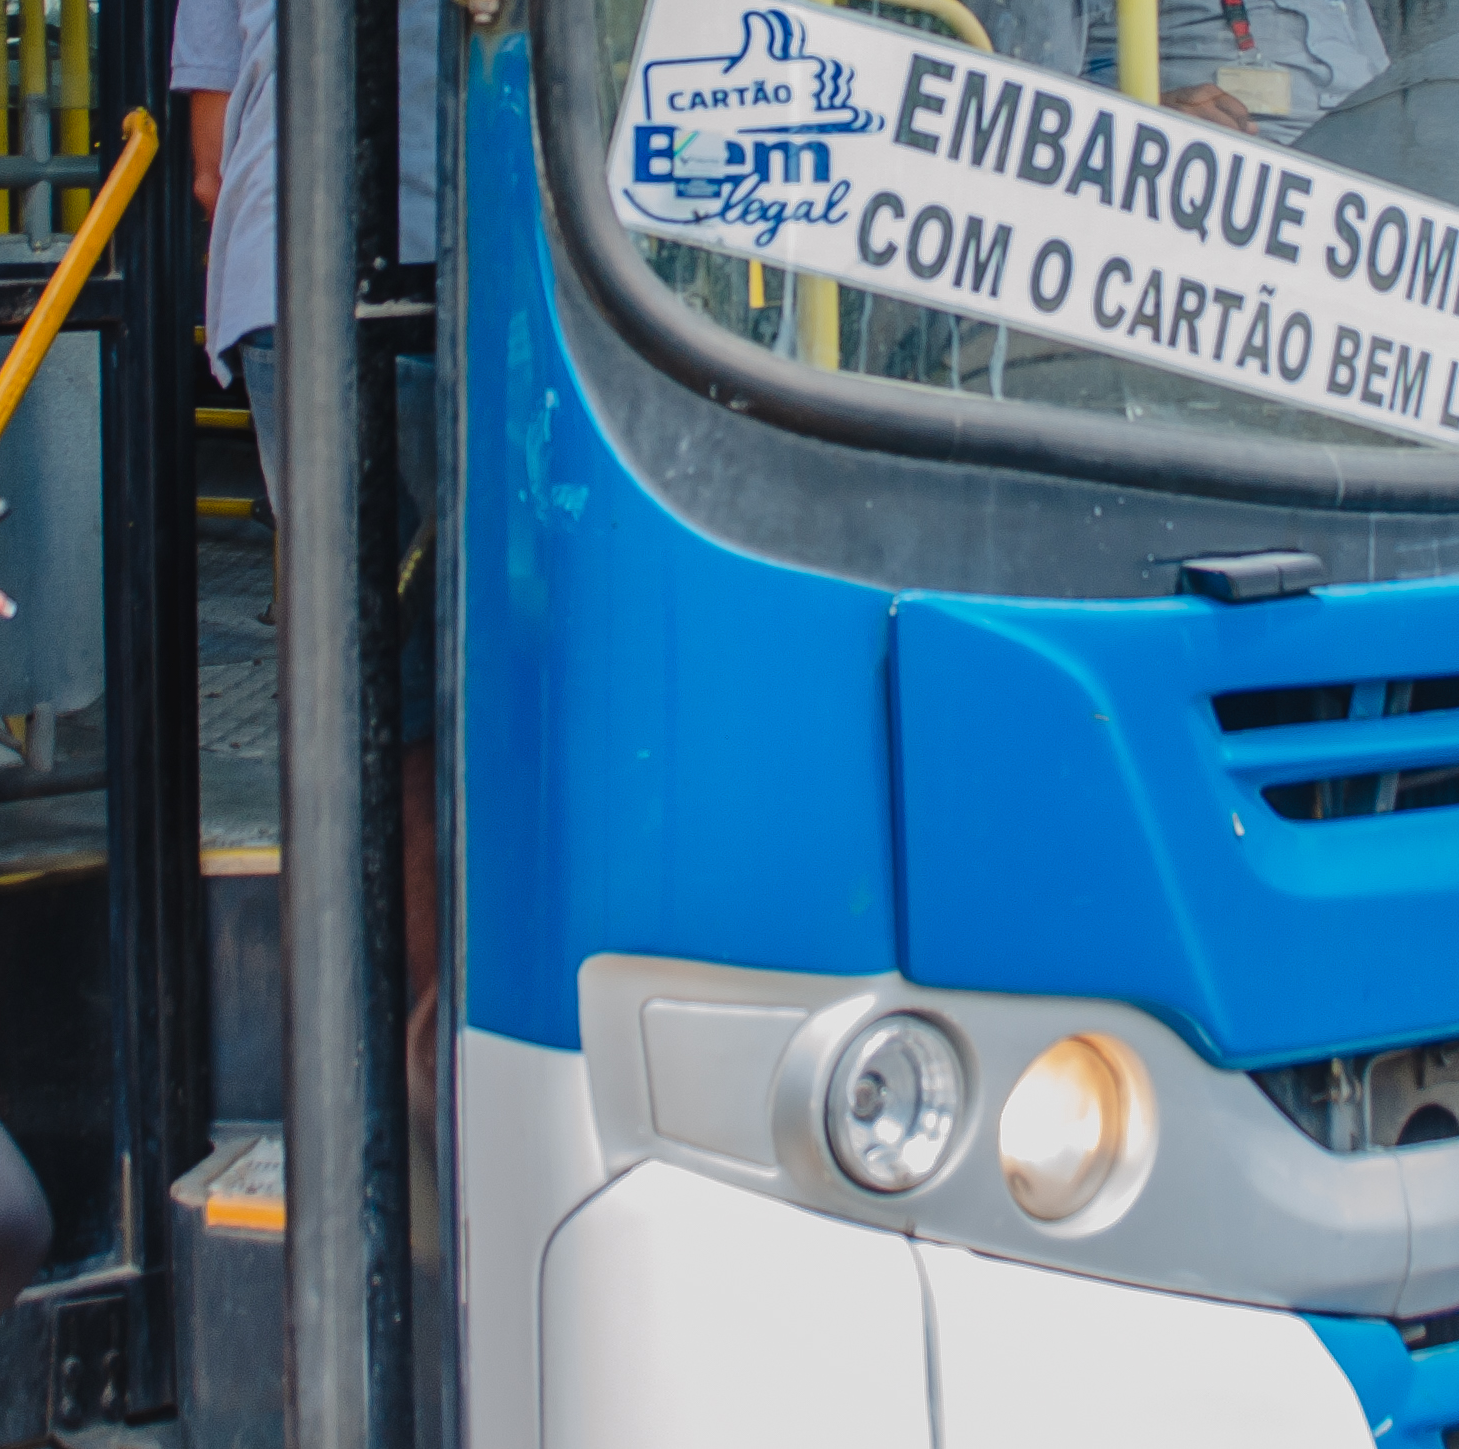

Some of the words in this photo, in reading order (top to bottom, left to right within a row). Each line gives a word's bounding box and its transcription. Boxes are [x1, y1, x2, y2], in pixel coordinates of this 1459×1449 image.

[667, 79, 793, 112] CARTÃO
[893, 52, 1313, 264] EMBARQUE
[719, 171, 851, 248] legal
[857, 190, 1014, 300] COM
[1029, 238, 1074, 314] O
[1092, 256, 1313, 383] CARTÃO
[1325, 324, 1432, 420] BEM
